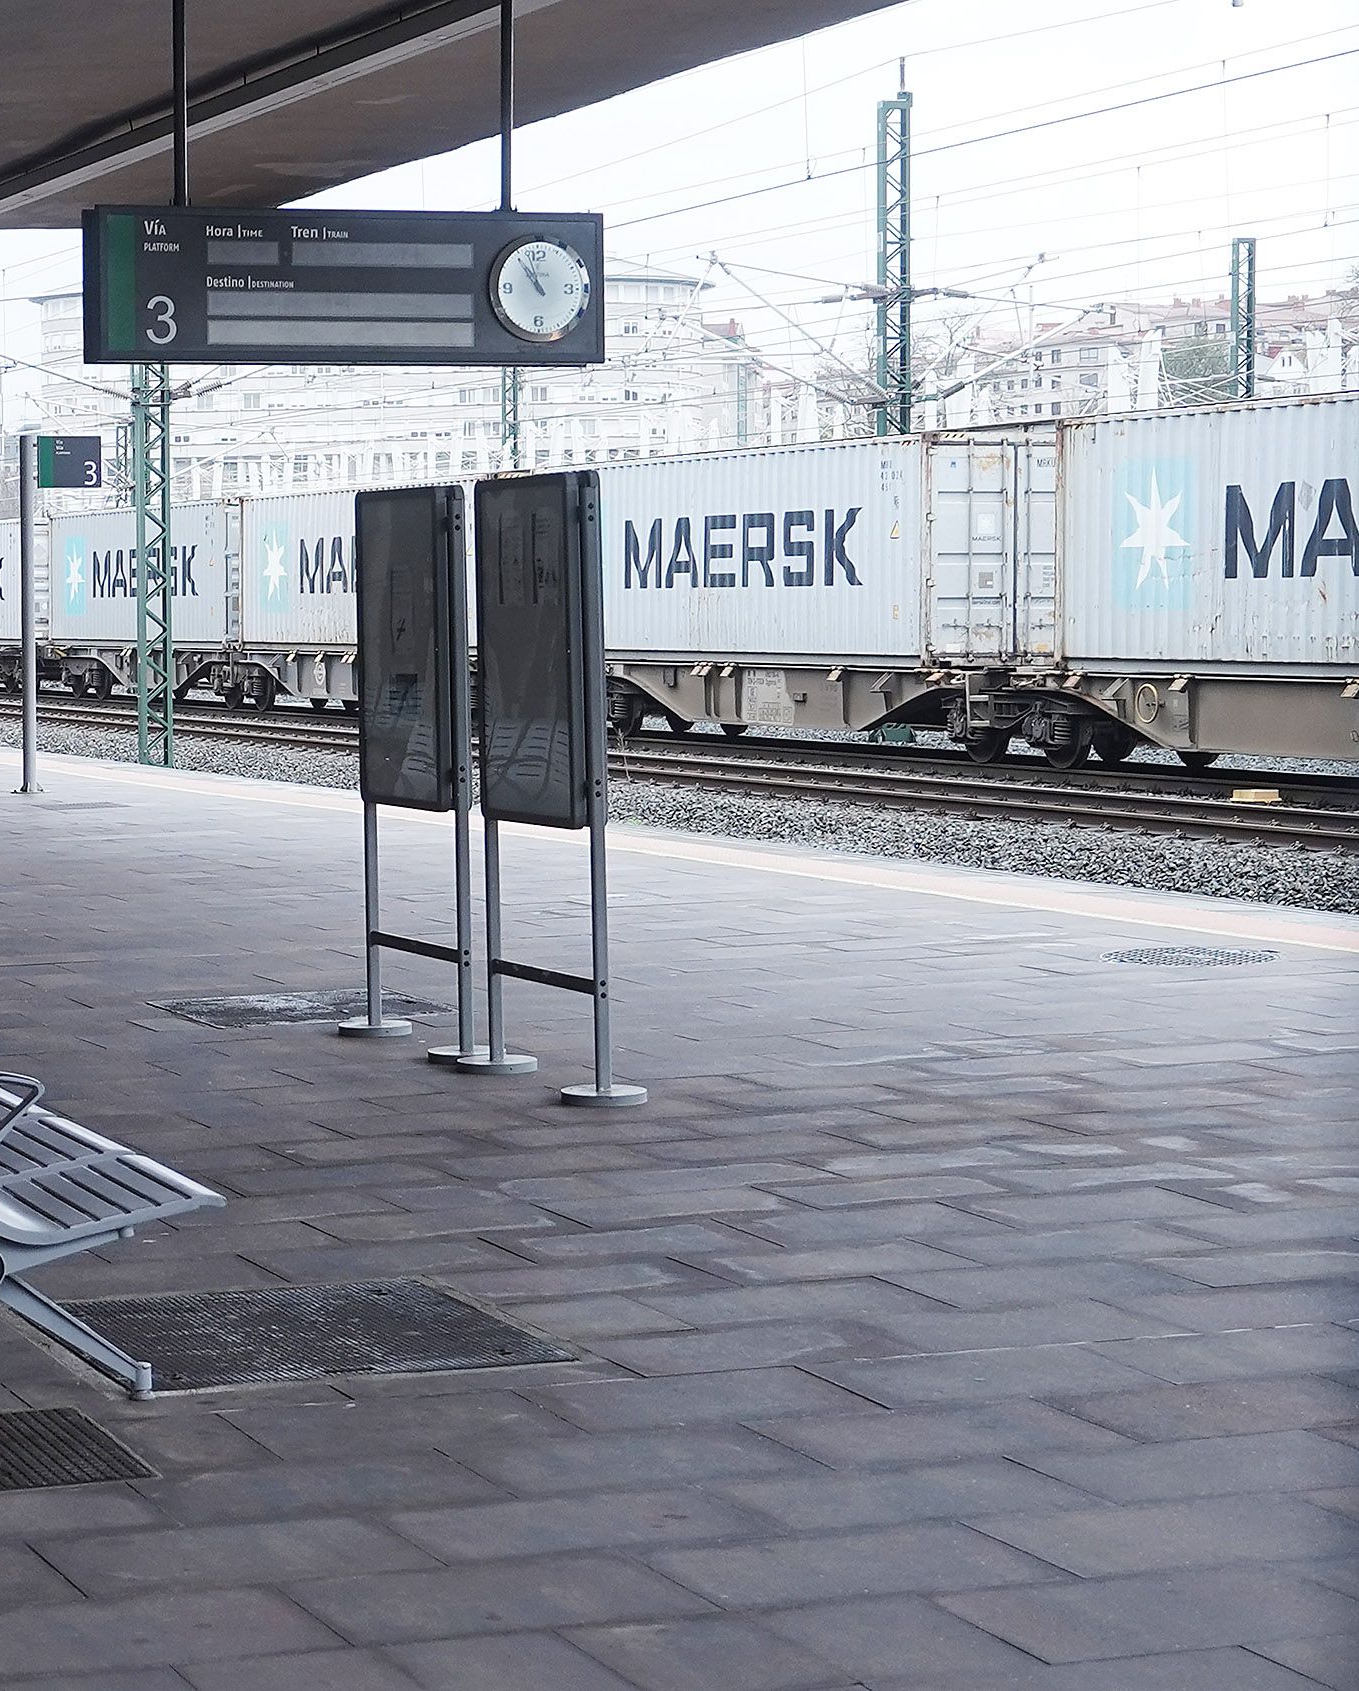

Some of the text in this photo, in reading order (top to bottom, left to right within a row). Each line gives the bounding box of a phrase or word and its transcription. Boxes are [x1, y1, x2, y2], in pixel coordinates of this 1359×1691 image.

[206, 225, 233, 237] Hora
[291, 226, 318, 238] Tren
[143, 242, 180, 252] PLATFORM
[206, 276, 244, 288] Destino
[502, 282, 513, 294] 9
[564, 283, 574, 295] 3
[146, 295, 178, 345] 3
[533, 315, 544, 327] 6
[83, 460, 98, 486] 3
[624, 506, 863, 589] MAERSK
[300, 536, 356, 594] MA
